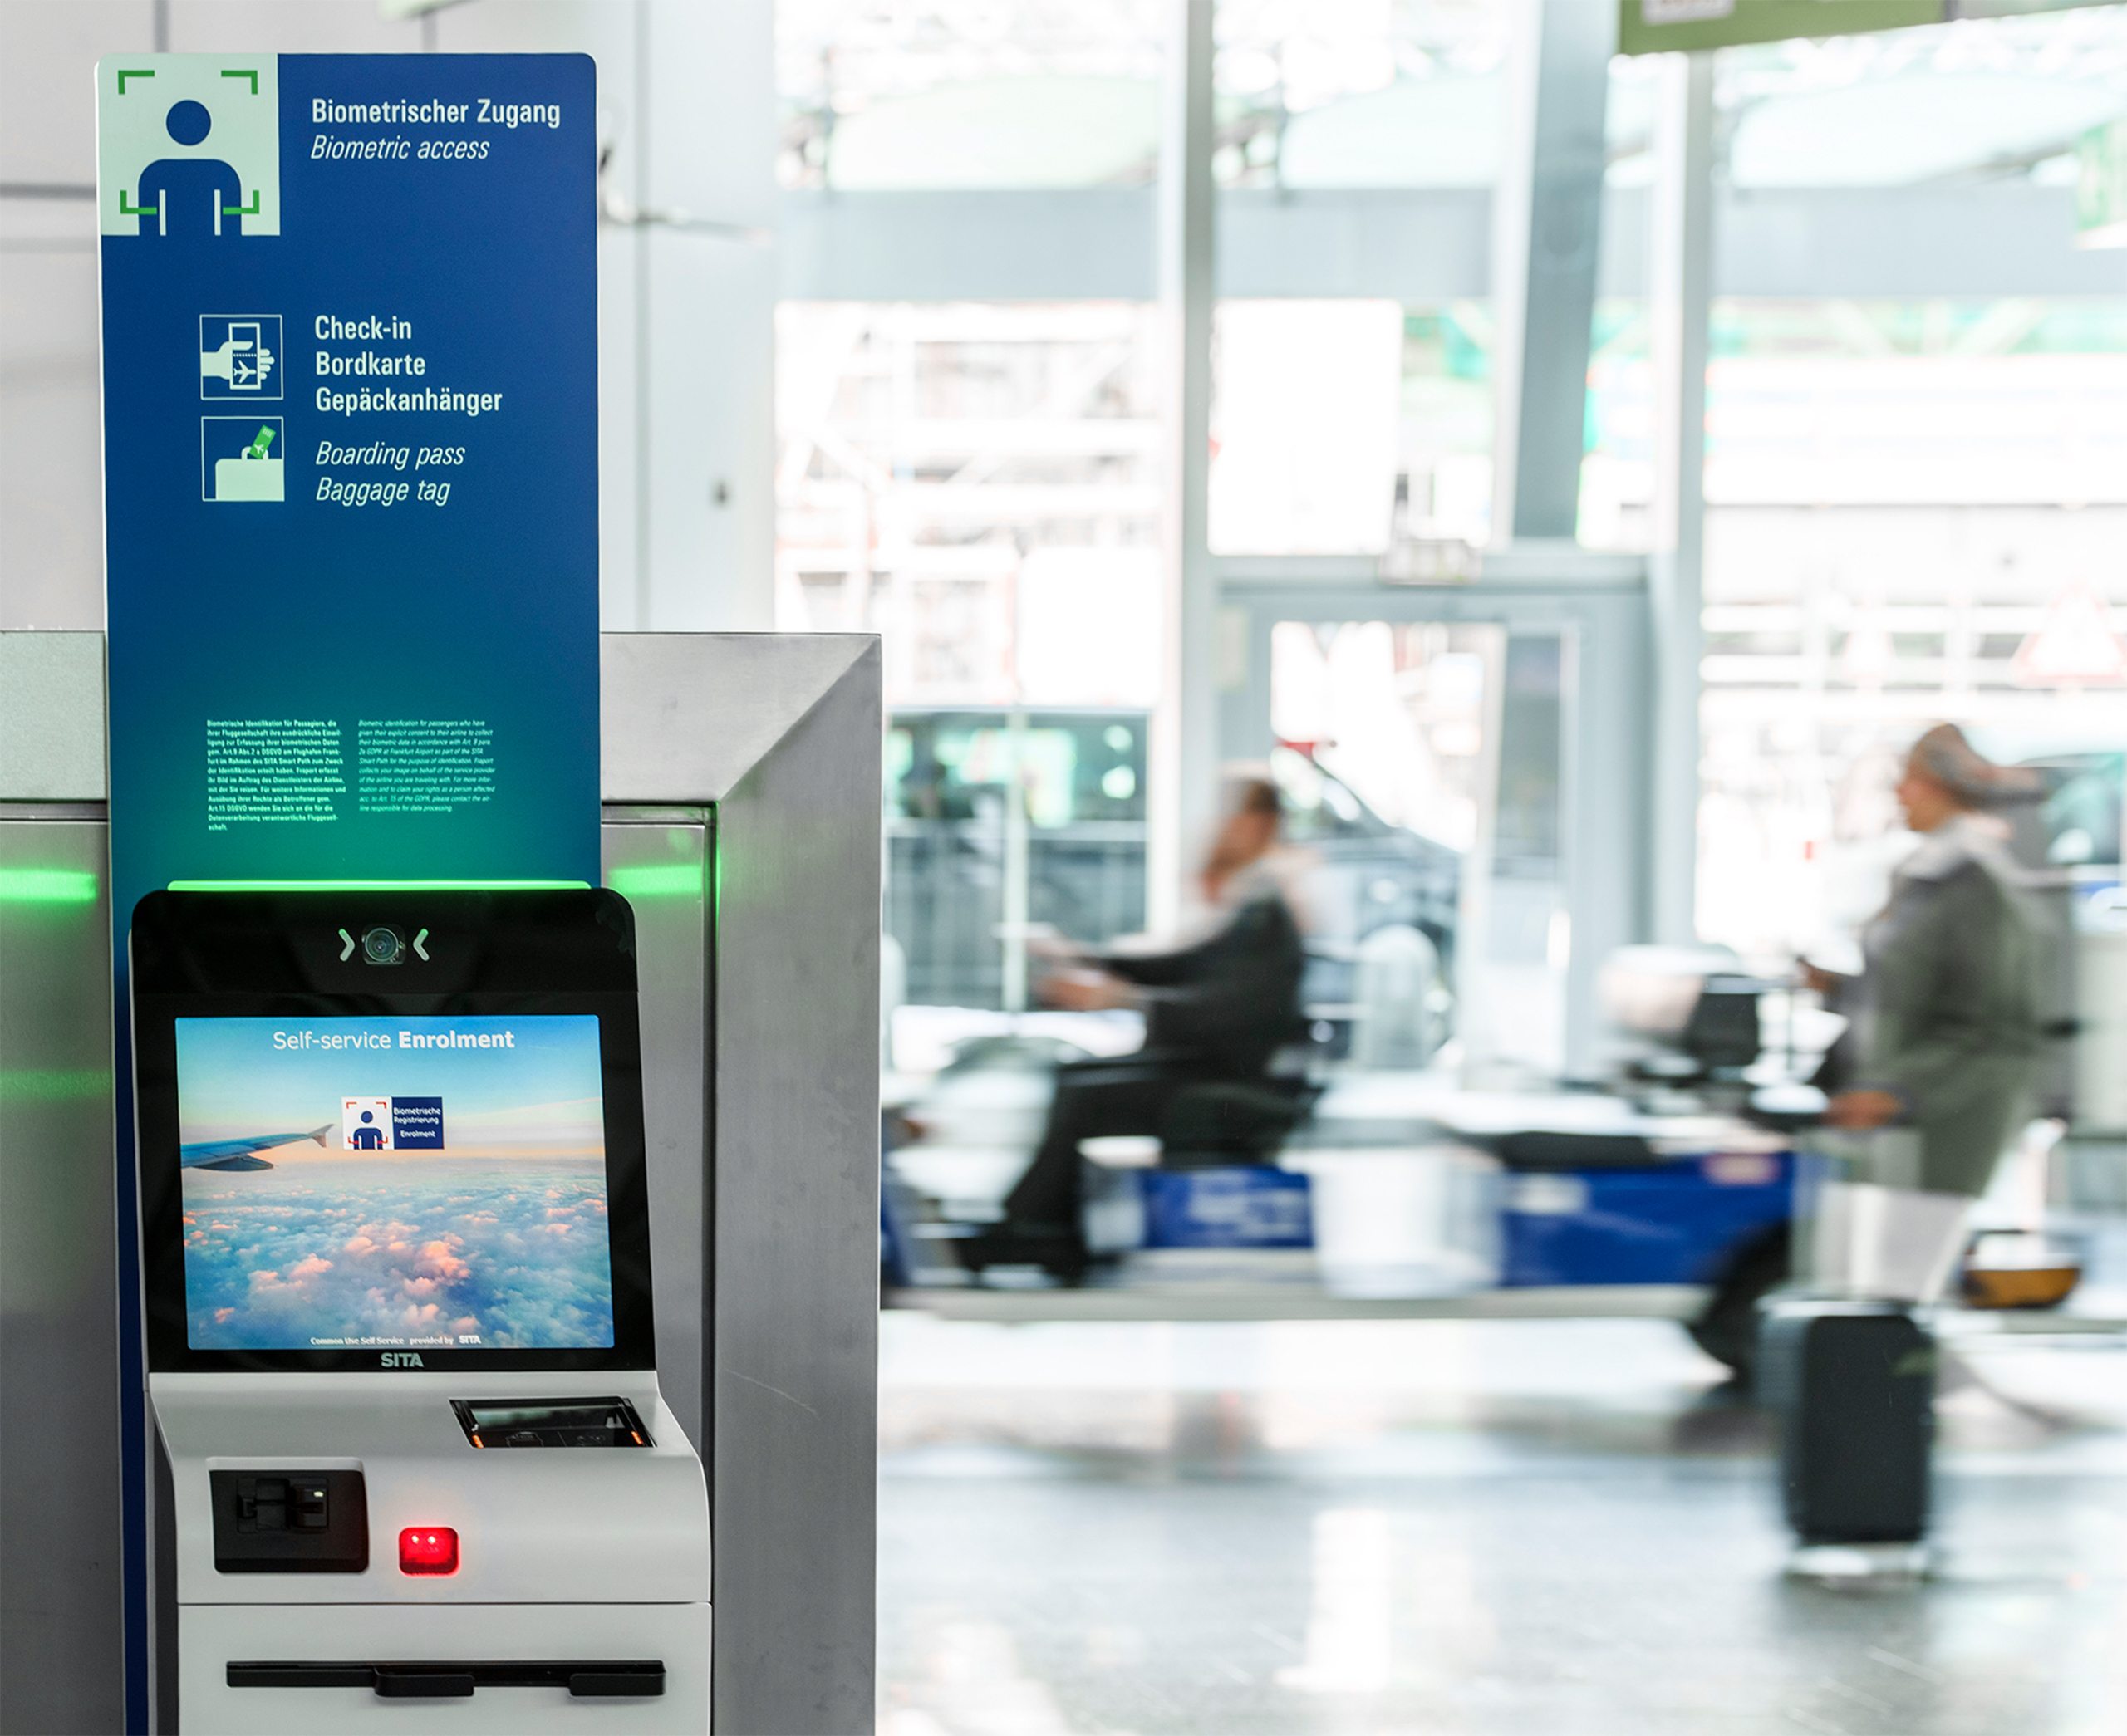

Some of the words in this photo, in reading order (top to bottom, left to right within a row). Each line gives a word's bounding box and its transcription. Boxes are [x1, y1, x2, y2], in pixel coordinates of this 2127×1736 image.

[313, 99, 469, 123] Biometrischer
[478, 99, 560, 128] Zugang
[311, 135, 410, 159] Biometric
[418, 141, 489, 159] access
[316, 316, 411, 339] Check-in
[317, 351, 425, 375] Bordkarte
[317, 387, 502, 416] Gepäckanhänger
[316, 441, 410, 470] Boarding
[415, 447, 465, 470] pass
[317, 478, 409, 506] Baggage
[418, 480, 450, 506] tag
[273, 1031, 391, 1049] Self-service
[399, 1031, 515, 1048] Enrolment
[394, 1106, 440, 1115] Biometrische
[400, 1130, 435, 1138] Enrolment
[360, 1336, 375, 1345] Self
[410, 1336, 443, 1346] provided
[444, 1336, 454, 1346] by
[459, 1335, 482, 1344] SITA
[381, 1353, 424, 1367] SITA
